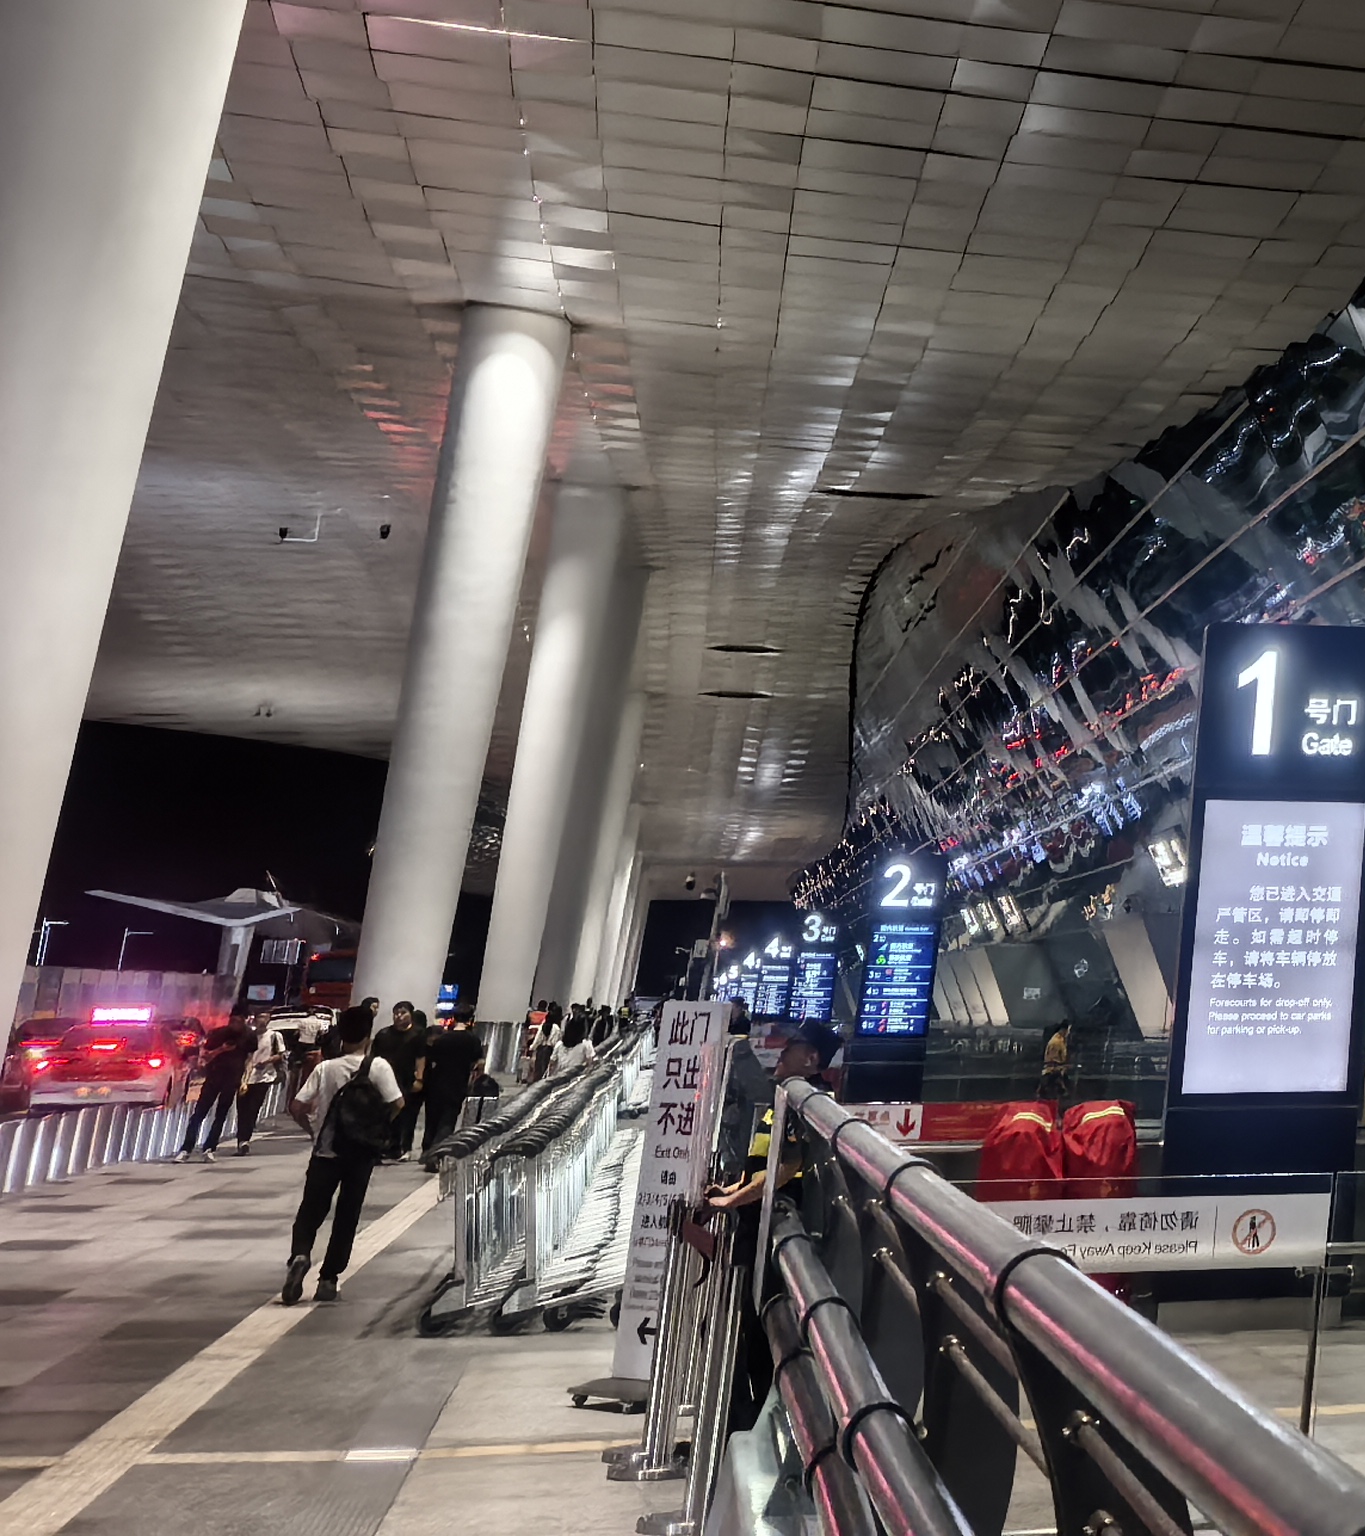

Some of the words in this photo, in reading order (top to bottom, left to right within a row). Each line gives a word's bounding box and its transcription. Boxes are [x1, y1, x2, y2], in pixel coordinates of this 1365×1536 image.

[1237, 651, 1277, 755] 1
[1304, 698, 1357, 725] 号门
[1301, 732, 1353, 756] Gate
[1256, 852, 1308, 866] Notice
[880, 864, 911, 907] 2
[1249, 885, 1342, 902] 您已进入交通
[802, 914, 822, 942] 3
[764, 936, 780, 958] 4
[1209, 997, 1257, 1007] Forecourts
[1260, 997, 1272, 1007] for
[1275, 997, 1310, 1009] drop-off
[668, 1011, 711, 1045] 此门
[1208, 1011, 1239, 1021] Please
[1241, 1011, 1277, 1022] proceed
[1280, 1011, 1289, 1020] to
[1290, 1012, 1306, 1020] car
[1307, 1011, 1332, 1022] parks
[1207, 1025, 1219, 1035] for
[1221, 1024, 1254, 1036] parking
[1256, 1026, 1266, 1034] or
[662, 1055, 700, 1089] 只出
[657, 1102, 696, 1135] 不进
